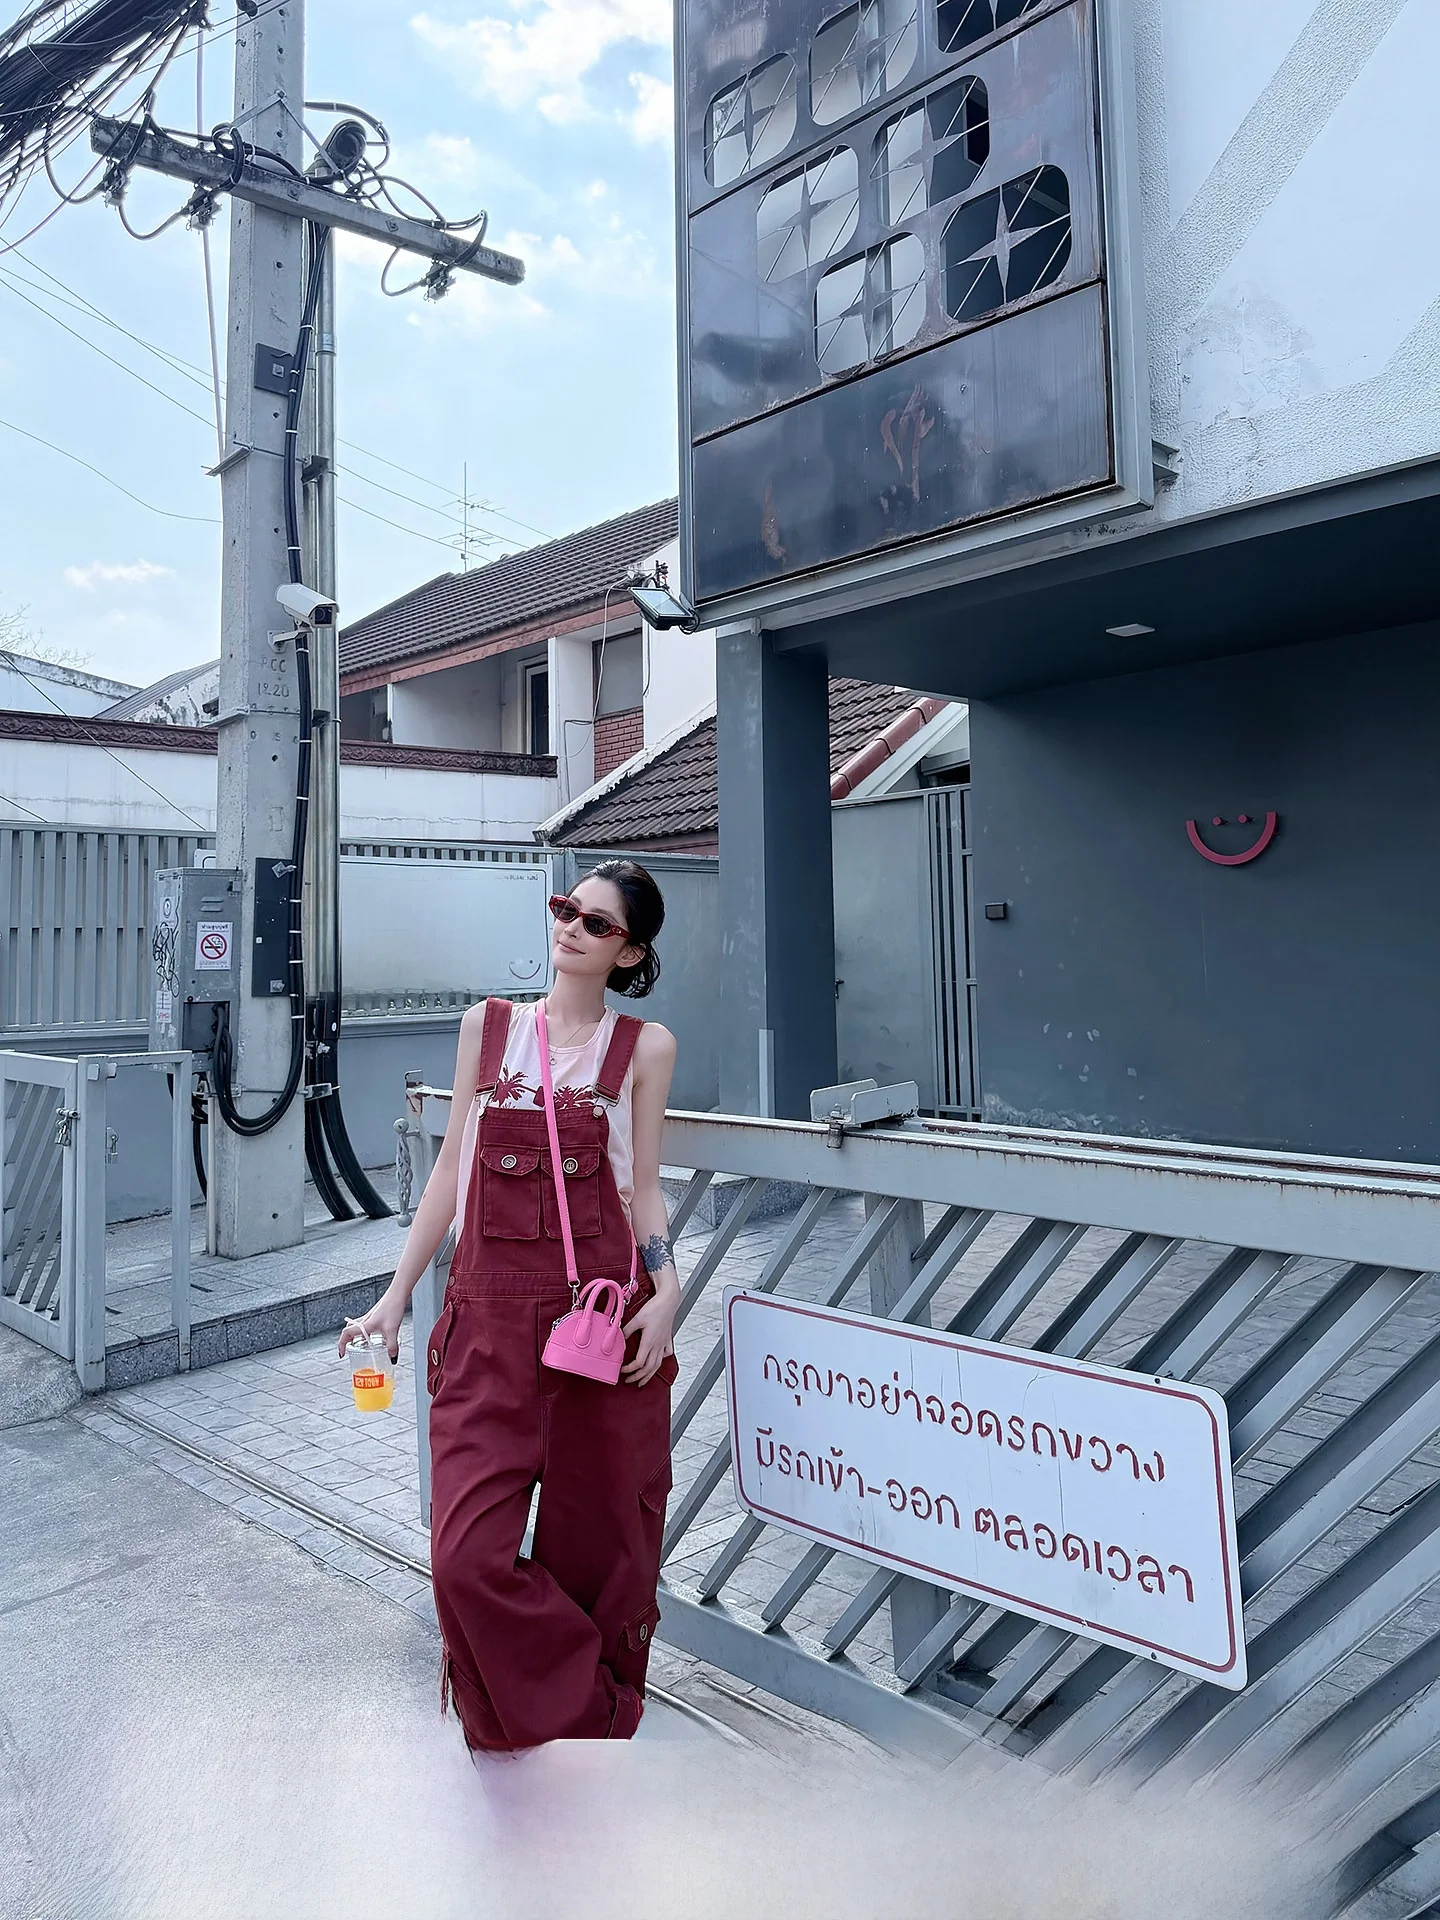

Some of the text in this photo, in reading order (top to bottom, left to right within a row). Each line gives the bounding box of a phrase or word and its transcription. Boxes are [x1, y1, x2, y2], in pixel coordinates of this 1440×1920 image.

[762, 1352, 1166, 1483] กรุณาอย่าจอดรถขวาง
[755, 1426, 1195, 1603] มีรถเข้า-ออก ตลอดเวลา
